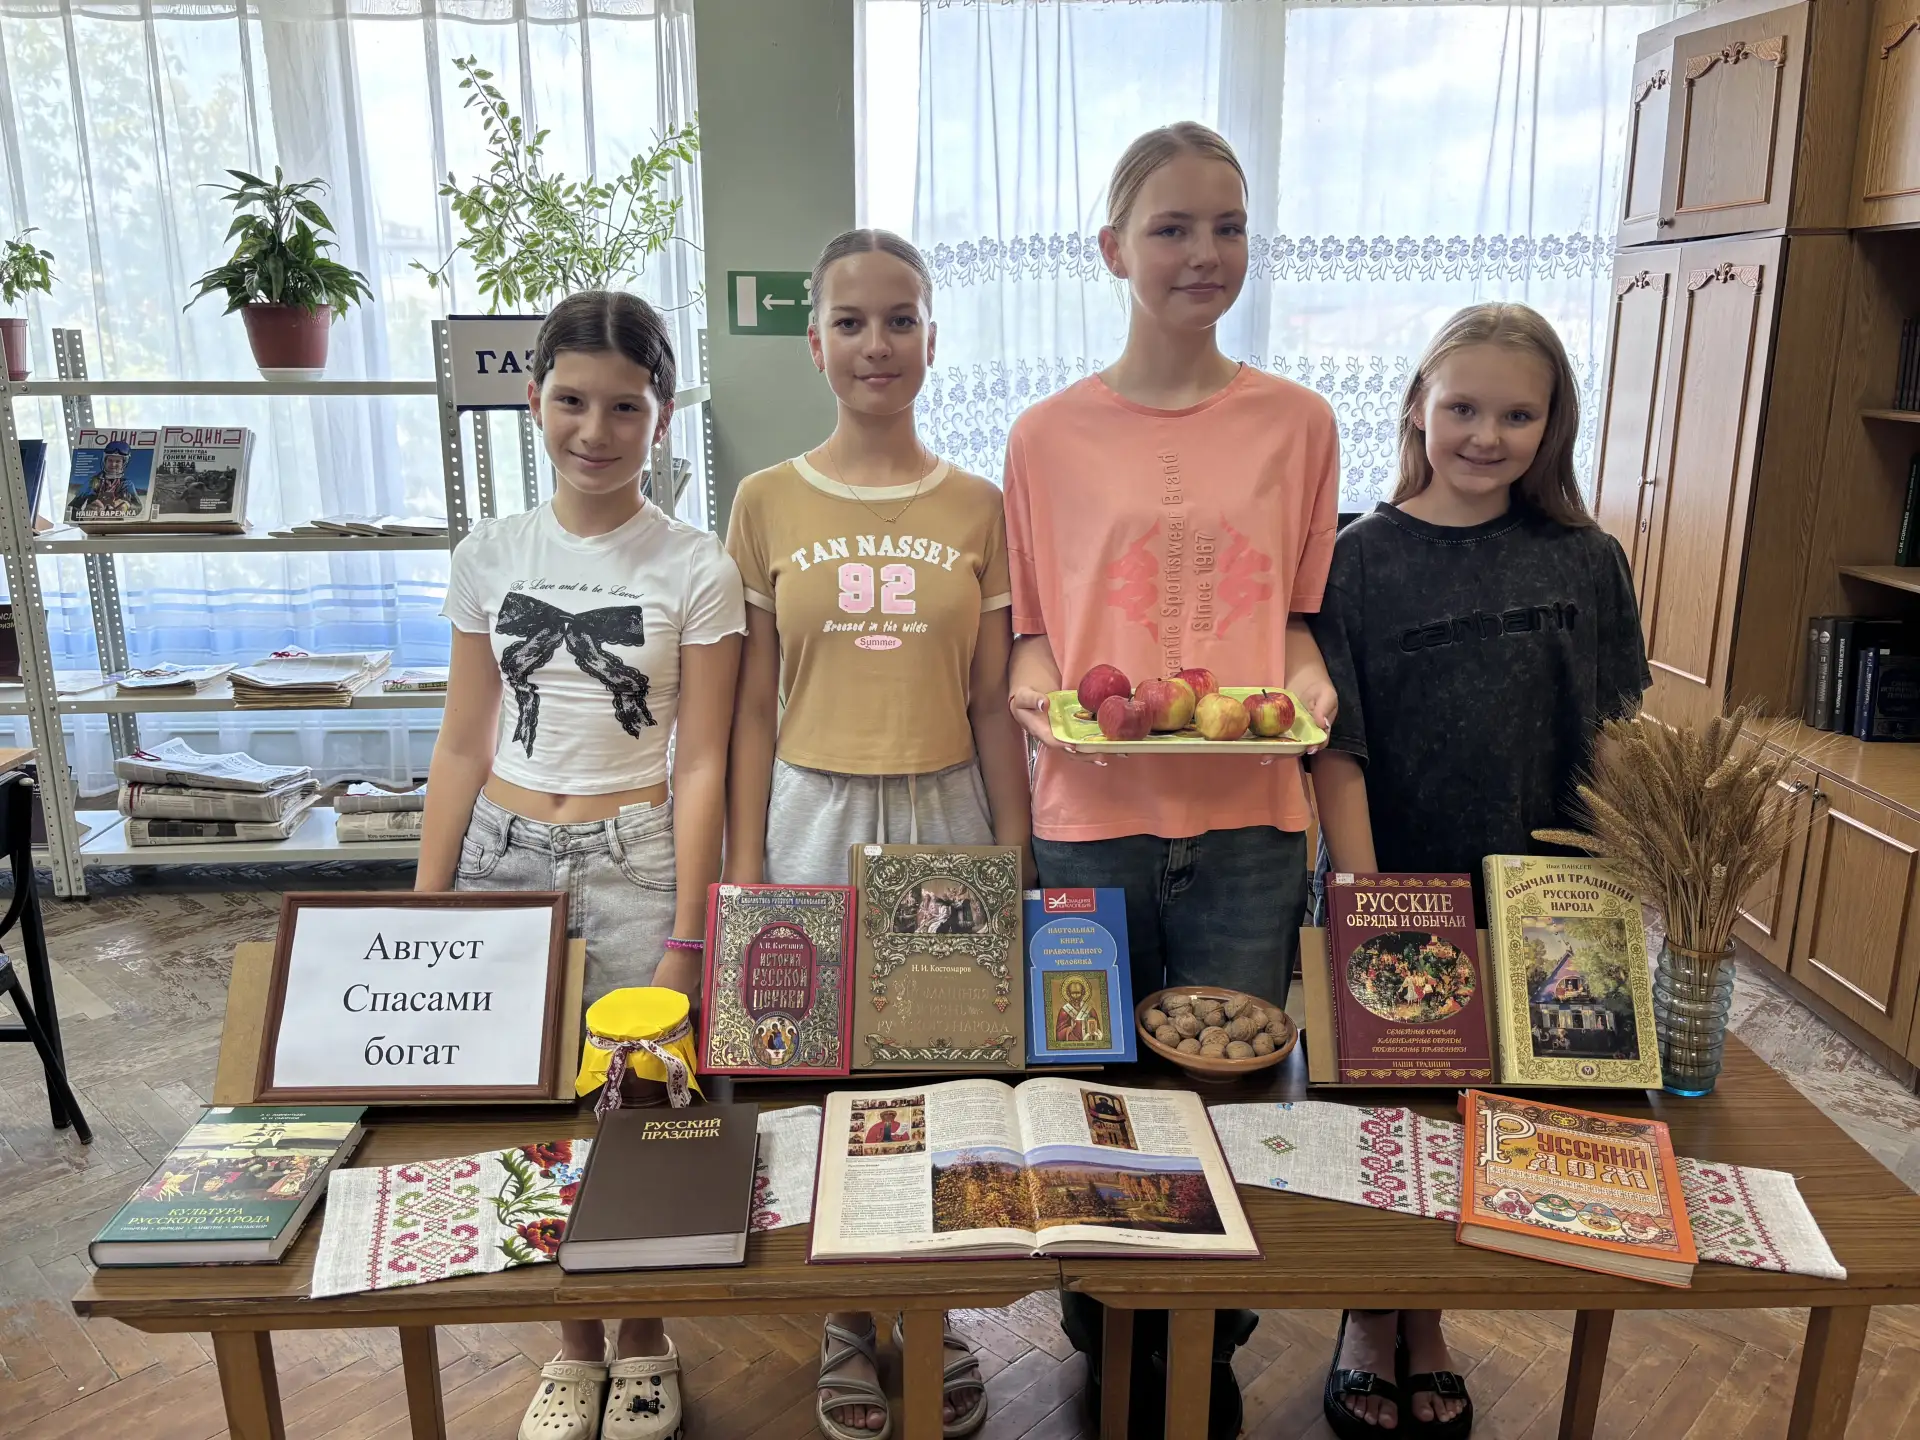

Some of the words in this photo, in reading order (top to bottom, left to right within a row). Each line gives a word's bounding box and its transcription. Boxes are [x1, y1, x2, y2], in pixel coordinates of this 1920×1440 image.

[165, 428, 242, 447] РОДИНА
[188, 454, 216, 462] НЕМЦЕВ
[1156, 450, 1184, 506] Brand
[100, 509, 137, 517] ВАРЕЖКА
[790, 536, 850, 572] TAN
[855, 534, 961, 572] NASSEY
[1193, 529, 1217, 577] 1967
[1160, 510, 1185, 618] Sportswear
[528, 577, 557, 591] Love
[557, 582, 580, 591] and
[579, 582, 593, 592] to
[592, 584, 603, 593] be
[607, 584, 645, 600] Loved
[837, 562, 916, 615] 92
[1191, 580, 1215, 632] Since
[882, 620, 898, 633] the
[902, 620, 929, 634] wilds
[1399, 600, 1579, 653] carhartt
[859, 637, 897, 647] Summer
[1505, 874, 1555, 899] ОБЫЧАИ
[1556, 873, 1566, 883] И
[1567, 873, 1635, 903] ТРАДИЦИИ
[1543, 889, 1600, 900] РУССКОГО
[1354, 892, 1454, 913] РУССКИЕ
[1550, 902, 1595, 913] НАРОДА
[1346, 914, 1399, 929] ОБРЯДЫ
[1400, 914, 1411, 927] И
[1412, 914, 1467, 928] ОБЫЧАИ
[363, 932, 484, 968] Август
[1043, 947, 1103, 956] ПРАВОСЛАВНОГО
[760, 953, 801, 967] ИСТОРИЯ
[930, 965, 972, 974] Костомаров
[752, 965, 808, 987] РУССКОЙ
[343, 983, 494, 1012] Спасами
[753, 989, 804, 1011] ЦЕРКВИ
[1377, 1037, 1432, 1045] КАЛЕНДАРНЫЕ
[1386, 1028, 1426, 1036] СЕМЕЙНЫЕ
[1426, 1028, 1456, 1036] ОБЫЧАИ
[364, 1035, 460, 1066] богат
[641, 1128, 720, 1140] ПРАЗДНИК
[644, 1117, 721, 1132] РУССКИЙ
[1525, 1152, 1650, 1190] ДОМ
[128, 1216, 207, 1225] РУССКОГО
[212, 1215, 270, 1224] НАРОДА
[168, 1207, 243, 1216] КУЛЬТУРА
